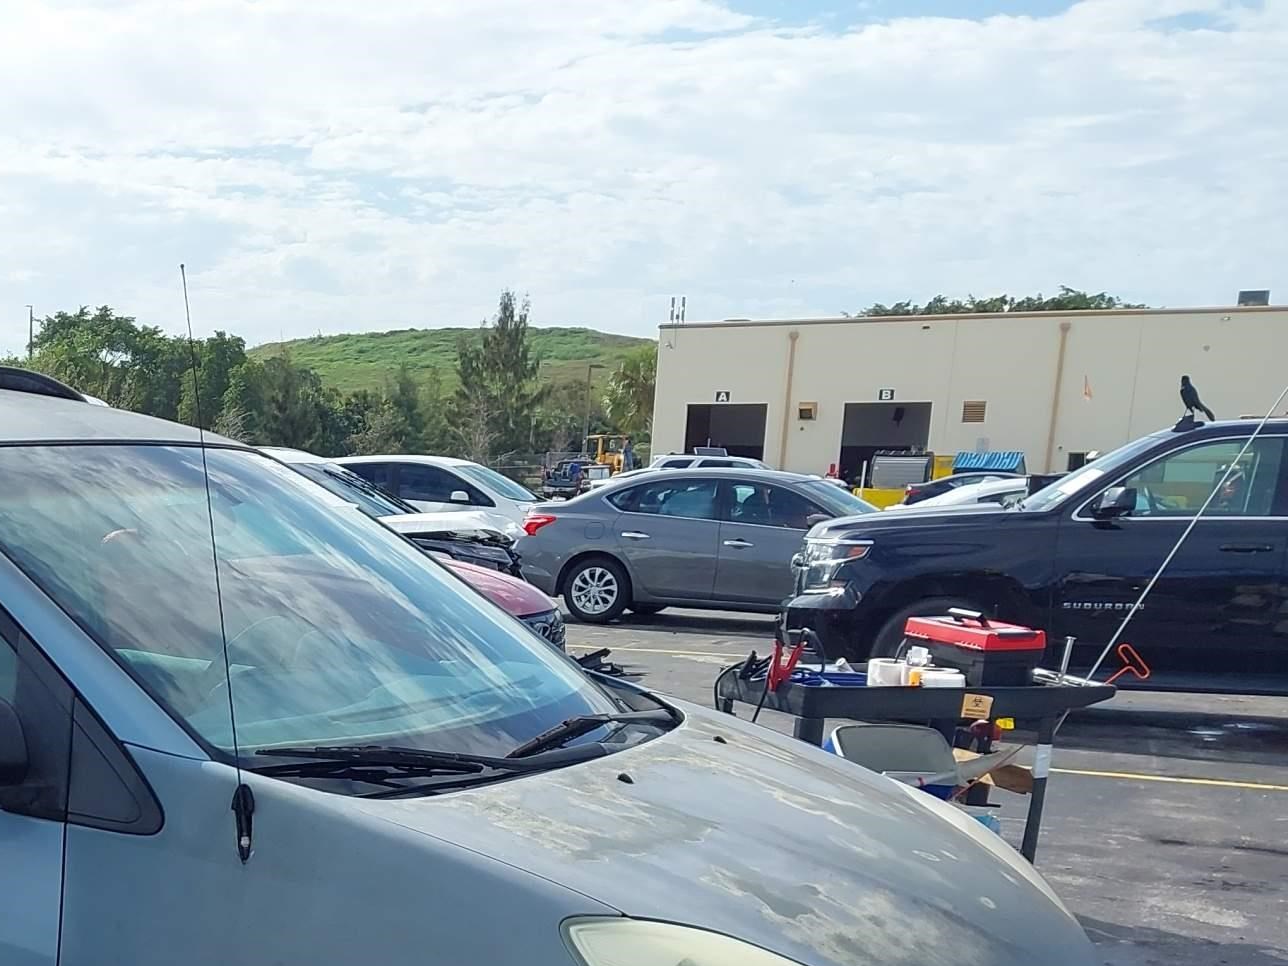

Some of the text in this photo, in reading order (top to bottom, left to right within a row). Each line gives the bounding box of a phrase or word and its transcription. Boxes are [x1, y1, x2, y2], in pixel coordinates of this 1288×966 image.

[718, 392, 728, 402] A
[882, 390, 892, 400] B
[1063, 602, 1145, 610] SUBURBAN
